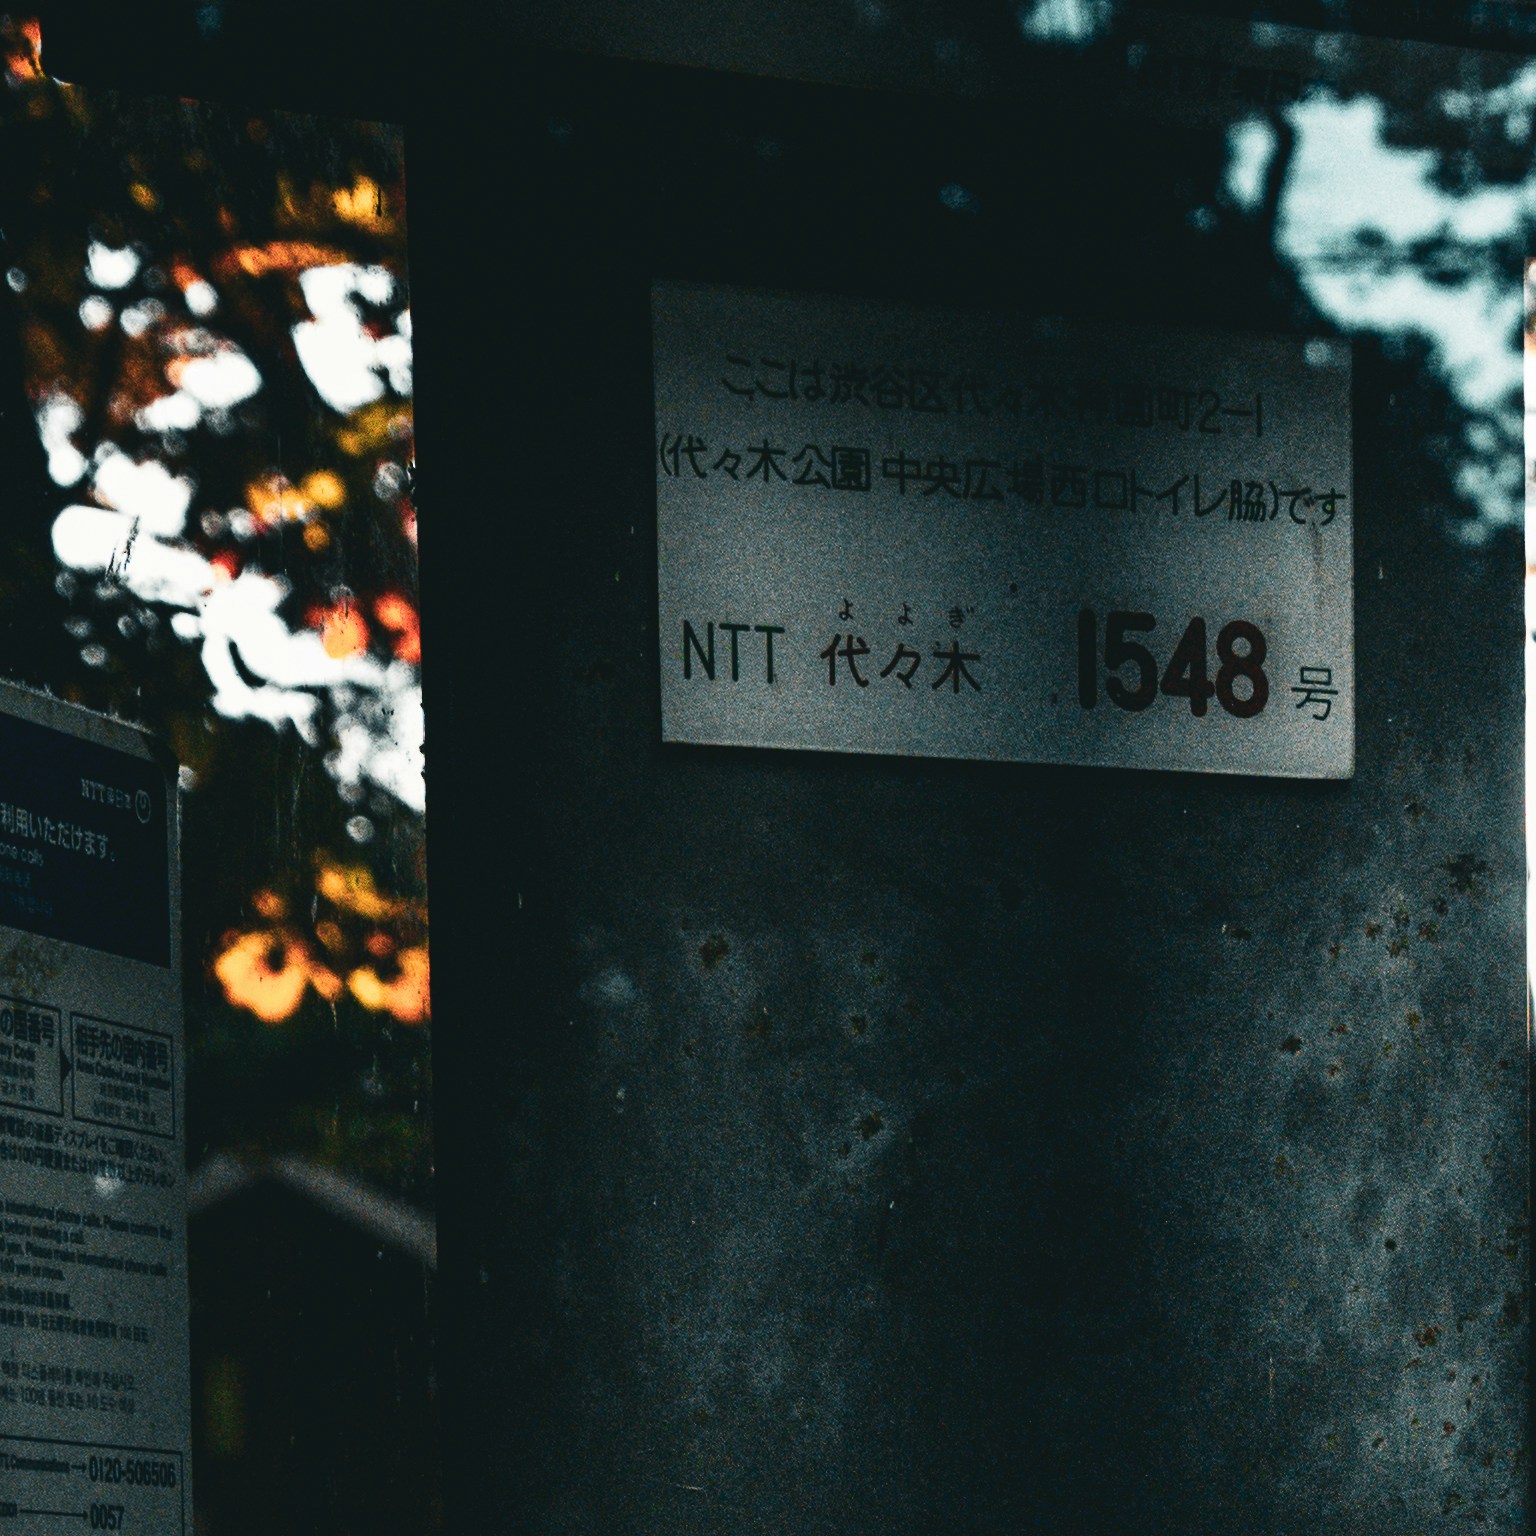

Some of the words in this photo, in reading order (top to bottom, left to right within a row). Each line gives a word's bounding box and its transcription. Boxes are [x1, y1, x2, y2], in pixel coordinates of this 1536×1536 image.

[683, 620, 785, 684] NTT
[820, 633, 981, 694] 代々木
[1078, 609, 1269, 718] 1548
[1291, 667, 1338, 721] 号
[89, 1455, 177, 1488] 0120-506506
[90, 1503, 125, 1531] 0057
